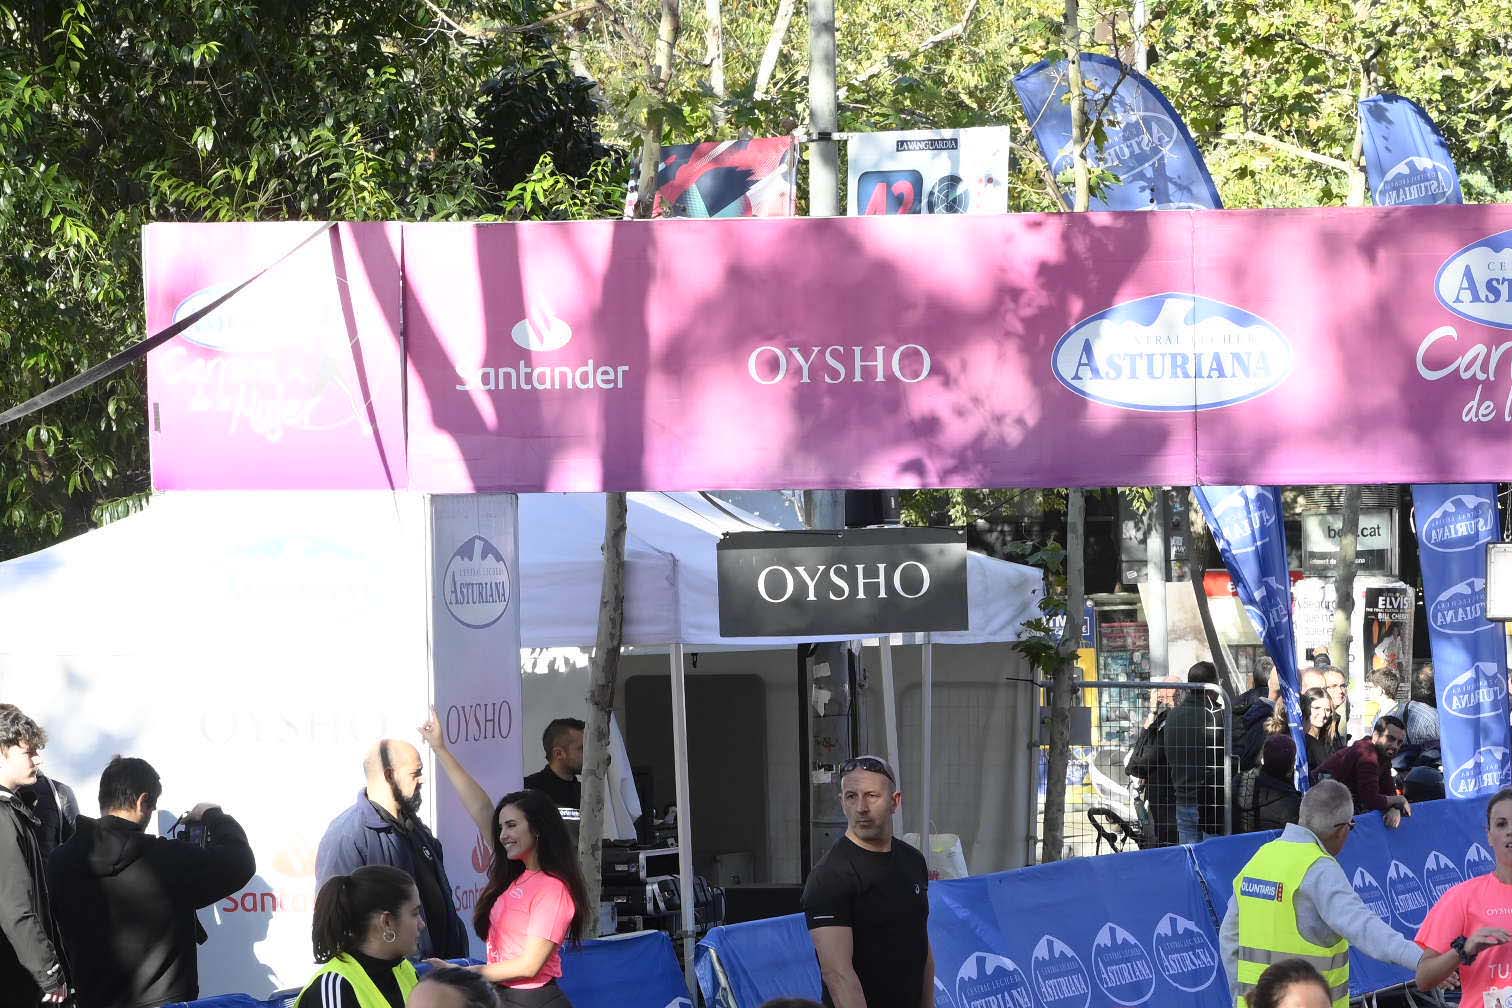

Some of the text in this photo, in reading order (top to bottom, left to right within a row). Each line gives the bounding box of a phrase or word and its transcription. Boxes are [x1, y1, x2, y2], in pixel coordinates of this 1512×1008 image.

[455, 360, 629, 392] Santander
[747, 343, 932, 386] OYSHO
[1071, 337, 1273, 381] ASTURIANA
[1461, 383, 1496, 423] de
[449, 570, 507, 606] ASTURIANA
[757, 560, 931, 604] OYSHO
[1378, 596, 1409, 609] ELVIS
[445, 700, 512, 745] OYSHO
[1039, 973, 1088, 1003] ASTURIANA
[1098, 957, 1153, 989] ASTURIANA
[1488, 962, 1511, 980] TU
